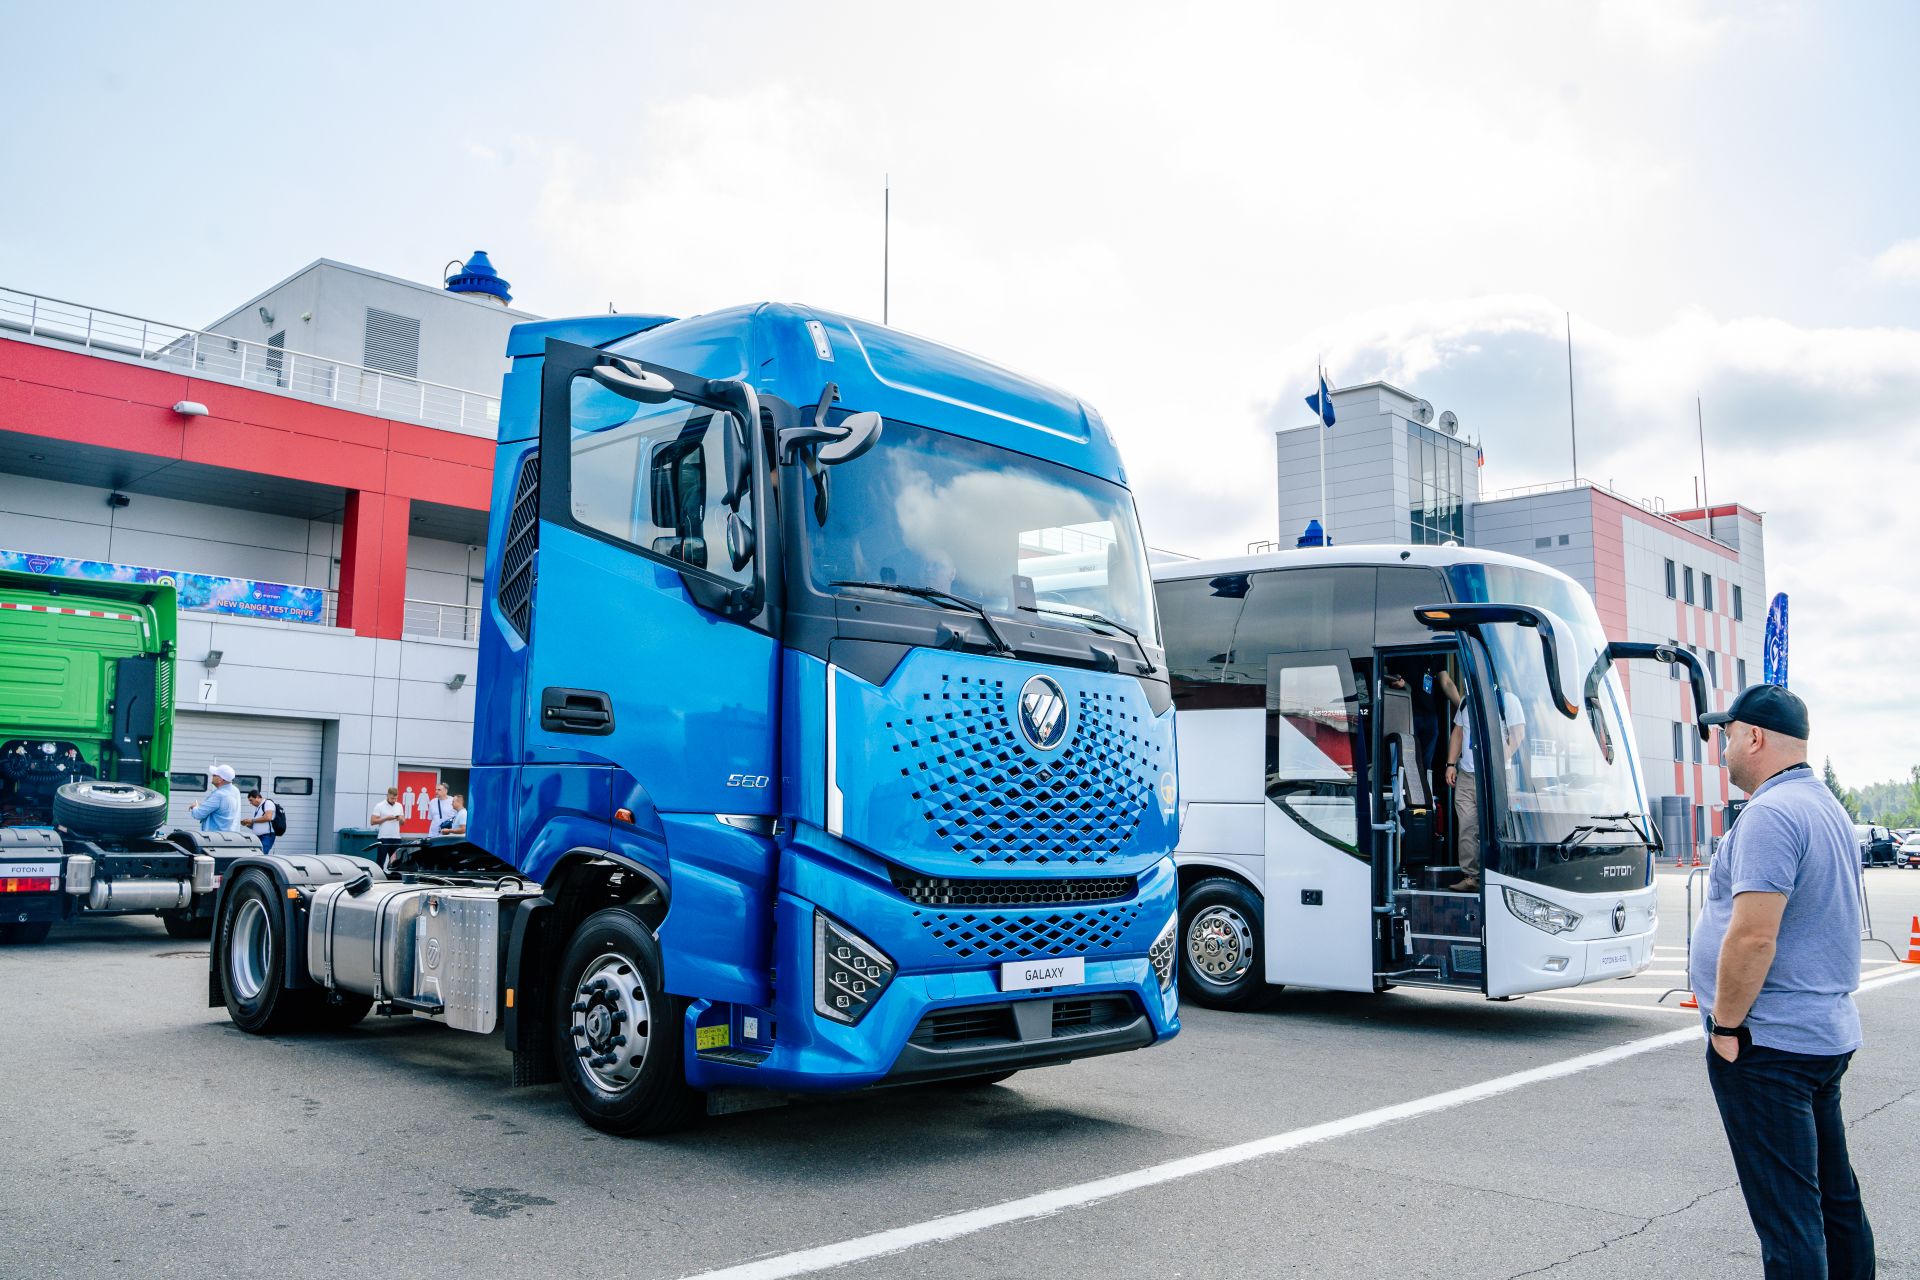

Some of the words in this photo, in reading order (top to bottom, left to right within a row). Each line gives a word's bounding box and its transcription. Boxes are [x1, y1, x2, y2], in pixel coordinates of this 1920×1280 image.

[217, 599, 238, 609] NEW
[239, 601, 267, 612] RANGE
[269, 605, 289, 614] TEST
[290, 607, 314, 617] DRIVE
[204, 683, 213, 700] 7
[726, 773, 770, 788] 560
[1603, 865, 1632, 877] FOTON
[1025, 966, 1064, 981] GALAXY
